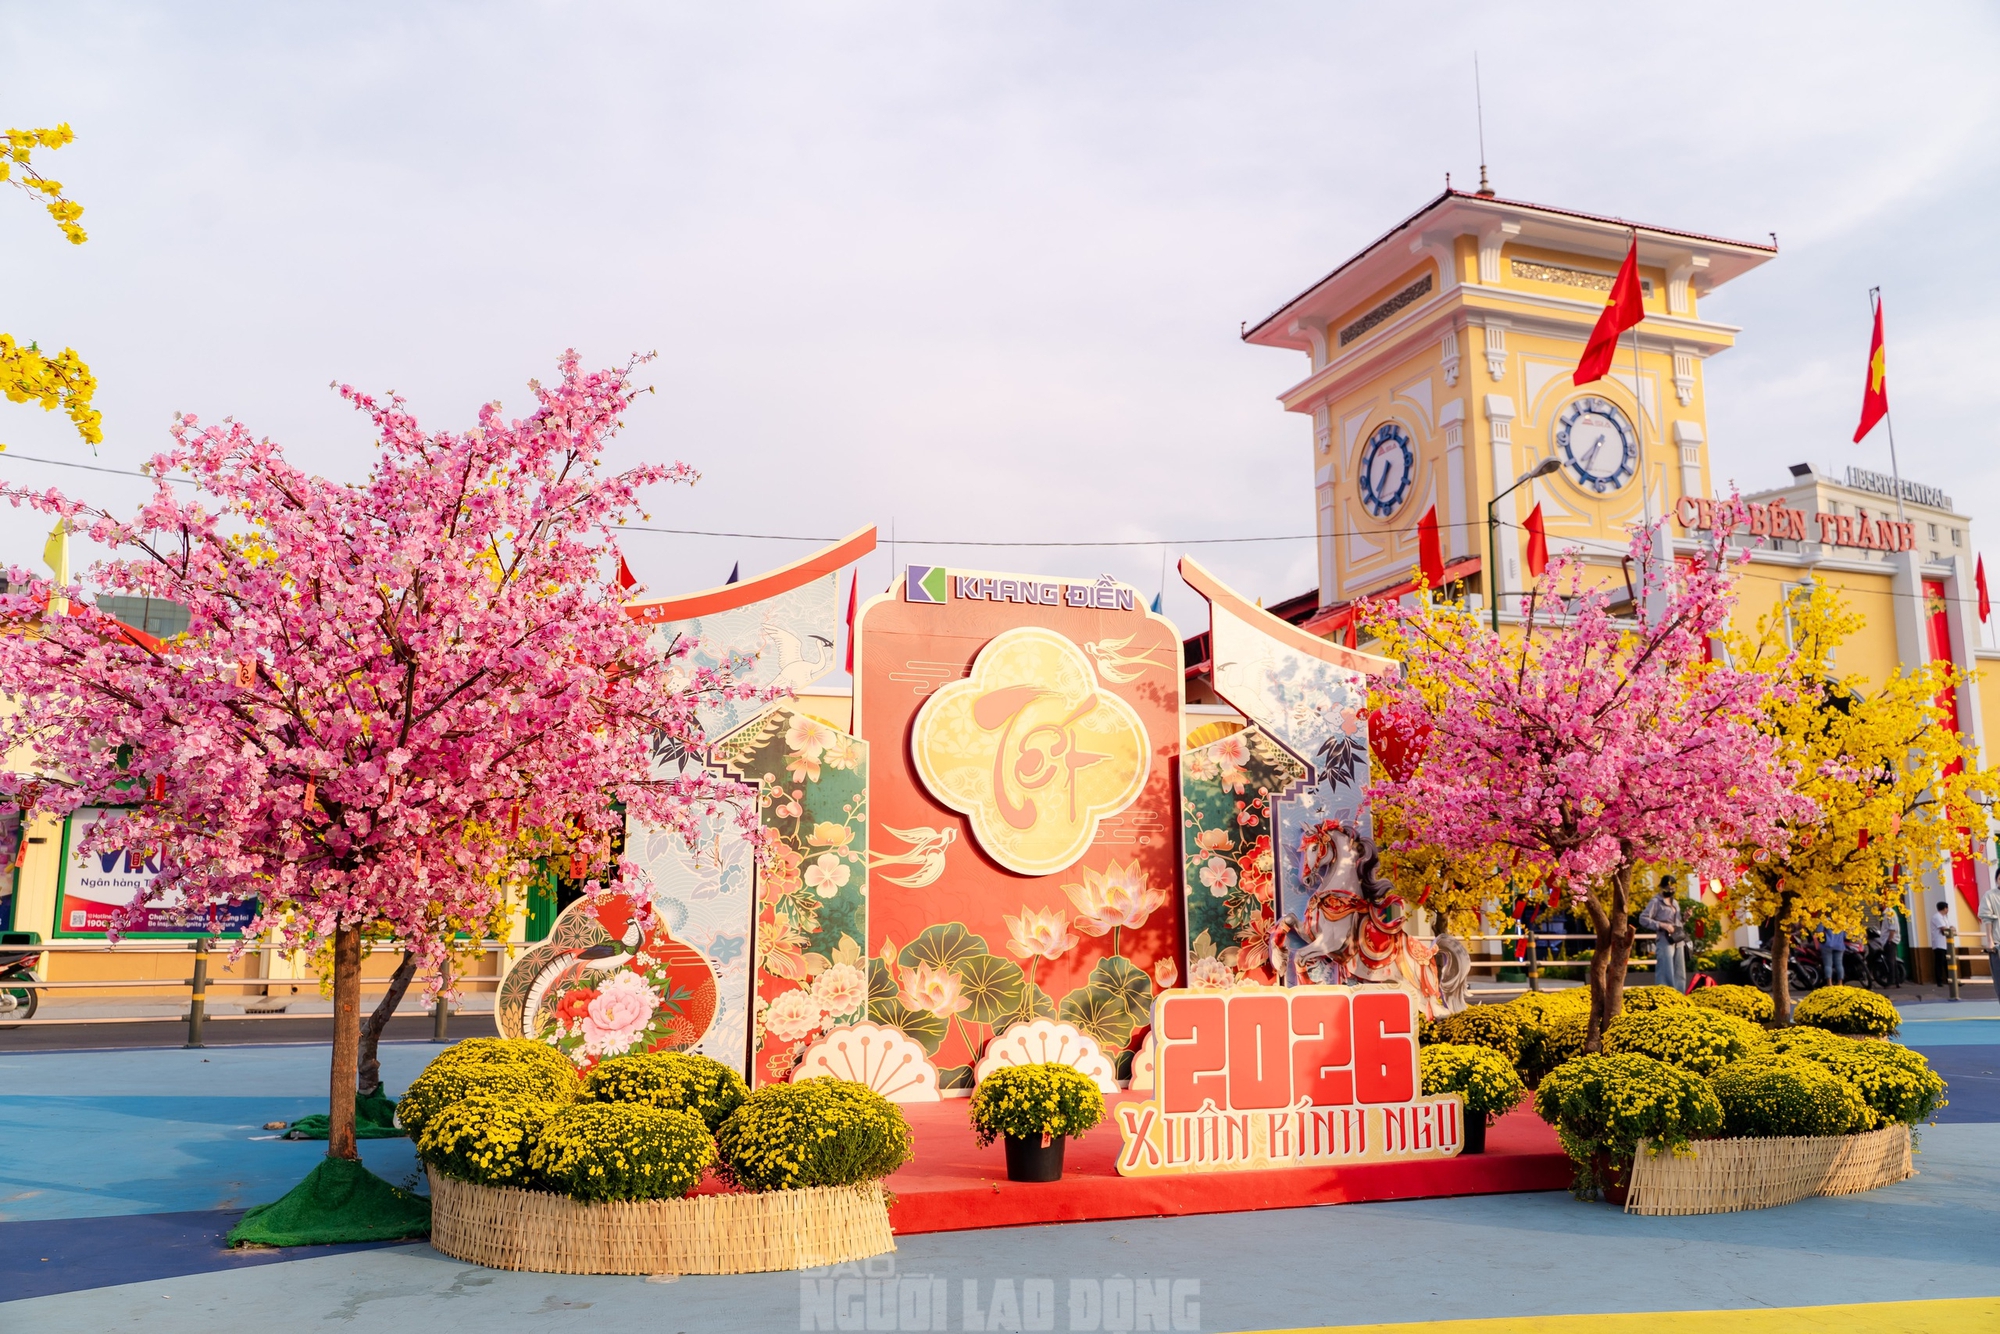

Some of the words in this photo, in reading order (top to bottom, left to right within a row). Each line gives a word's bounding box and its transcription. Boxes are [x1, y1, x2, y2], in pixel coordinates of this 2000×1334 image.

[1557, 431, 1569, 447] 9
[1594, 477, 1606, 493] 6
[1847, 466, 1897, 497] LIBERTY
[1748, 497, 1807, 541] BẾN
[1816, 509, 1918, 551] THÀNH
[957, 576, 1058, 605] KHANG
[1065, 573, 1134, 610] ĐIỀN
[80, 878, 110, 888] Ngân
[113, 878, 141, 888] hàng
[1163, 993, 1414, 1113] 2026
[1122, 1101, 1249, 1167] XUÂN
[1268, 1098, 1366, 1158] BÍNH
